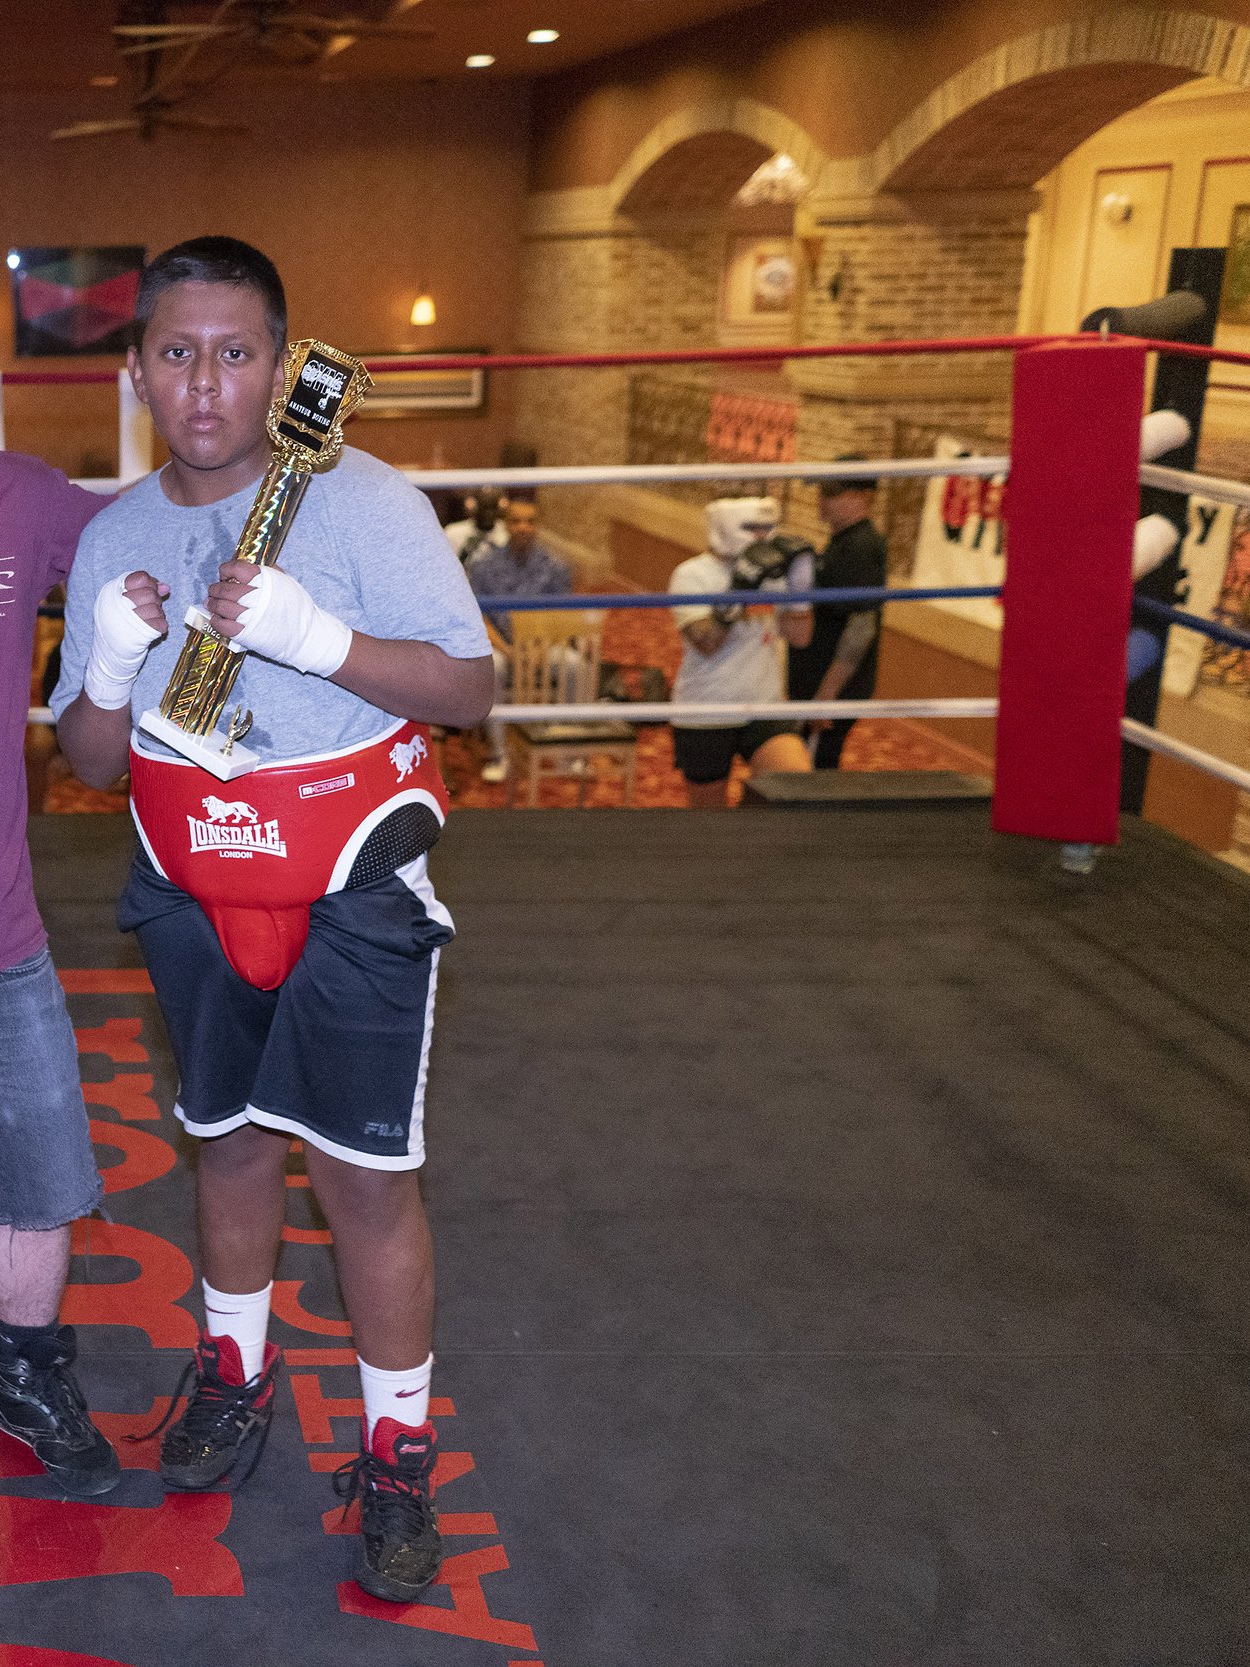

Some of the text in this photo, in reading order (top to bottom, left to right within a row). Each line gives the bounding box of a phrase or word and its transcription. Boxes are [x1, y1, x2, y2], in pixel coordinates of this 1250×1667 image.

[289, 401, 331, 427] AMATEUR BOXING
[187, 814, 287, 858] LONSDALE
[219, 850, 253, 859] LONDON
[364, 1121, 404, 1137] FILA
